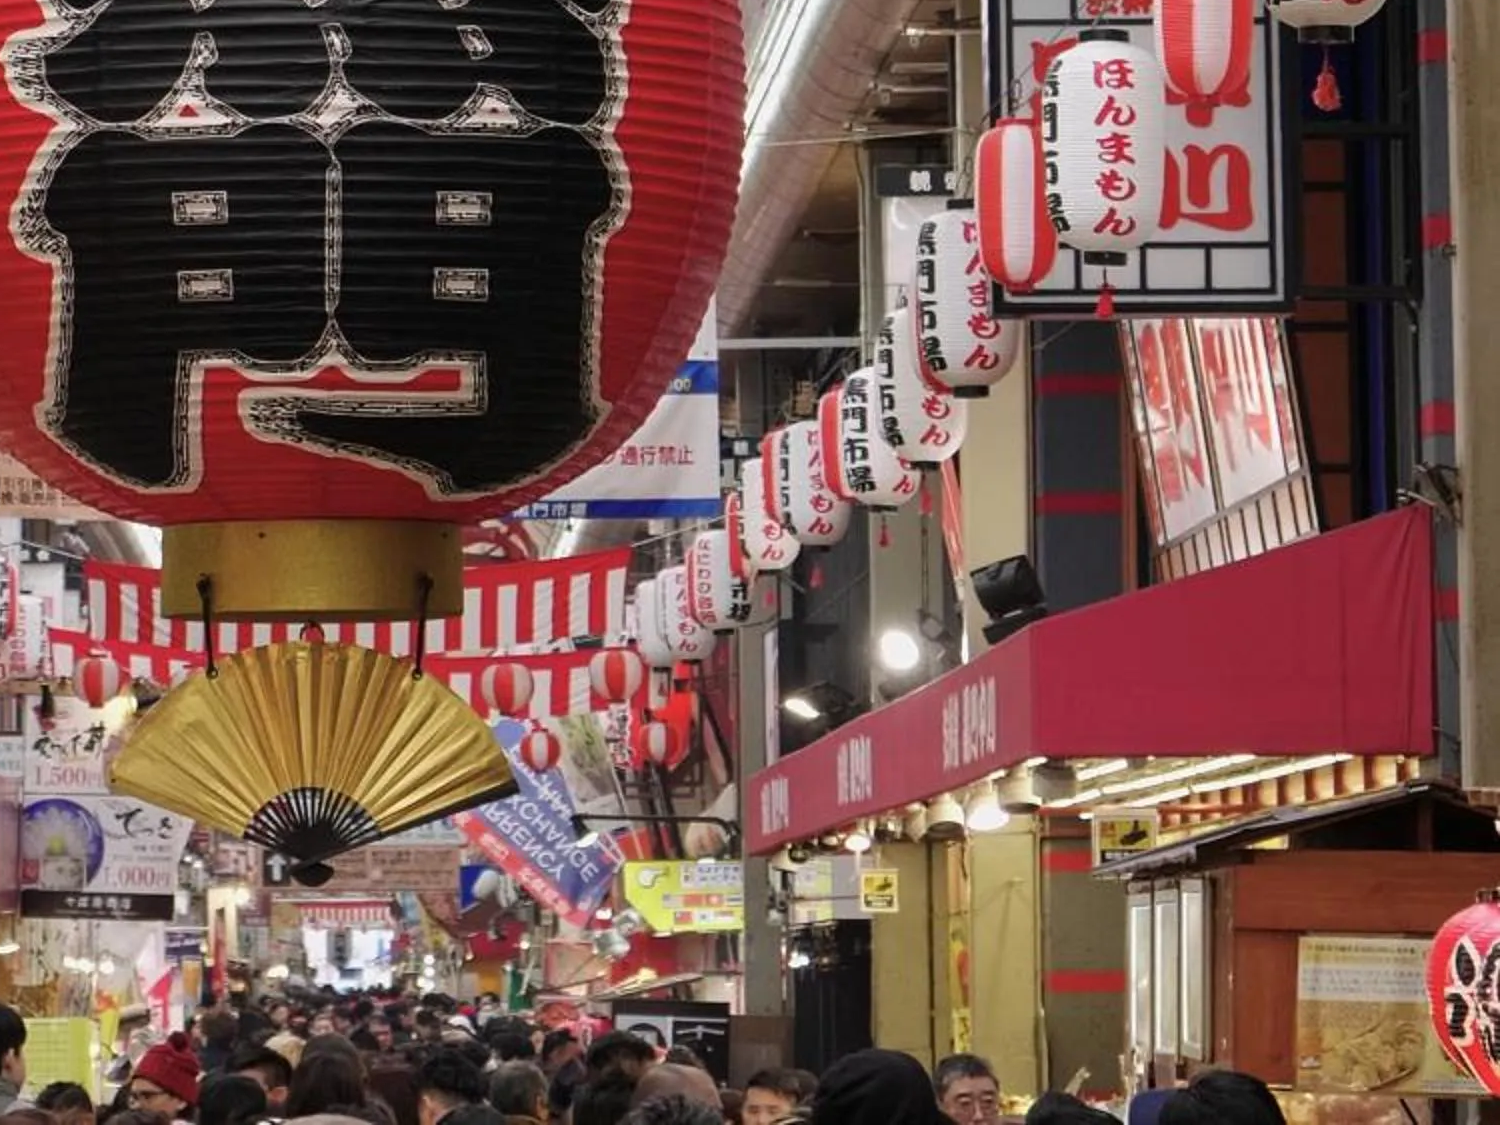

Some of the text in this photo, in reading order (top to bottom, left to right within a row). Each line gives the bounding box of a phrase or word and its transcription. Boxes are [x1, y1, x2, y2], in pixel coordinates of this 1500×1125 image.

[1093, 59, 1137, 236] ほんまもん
